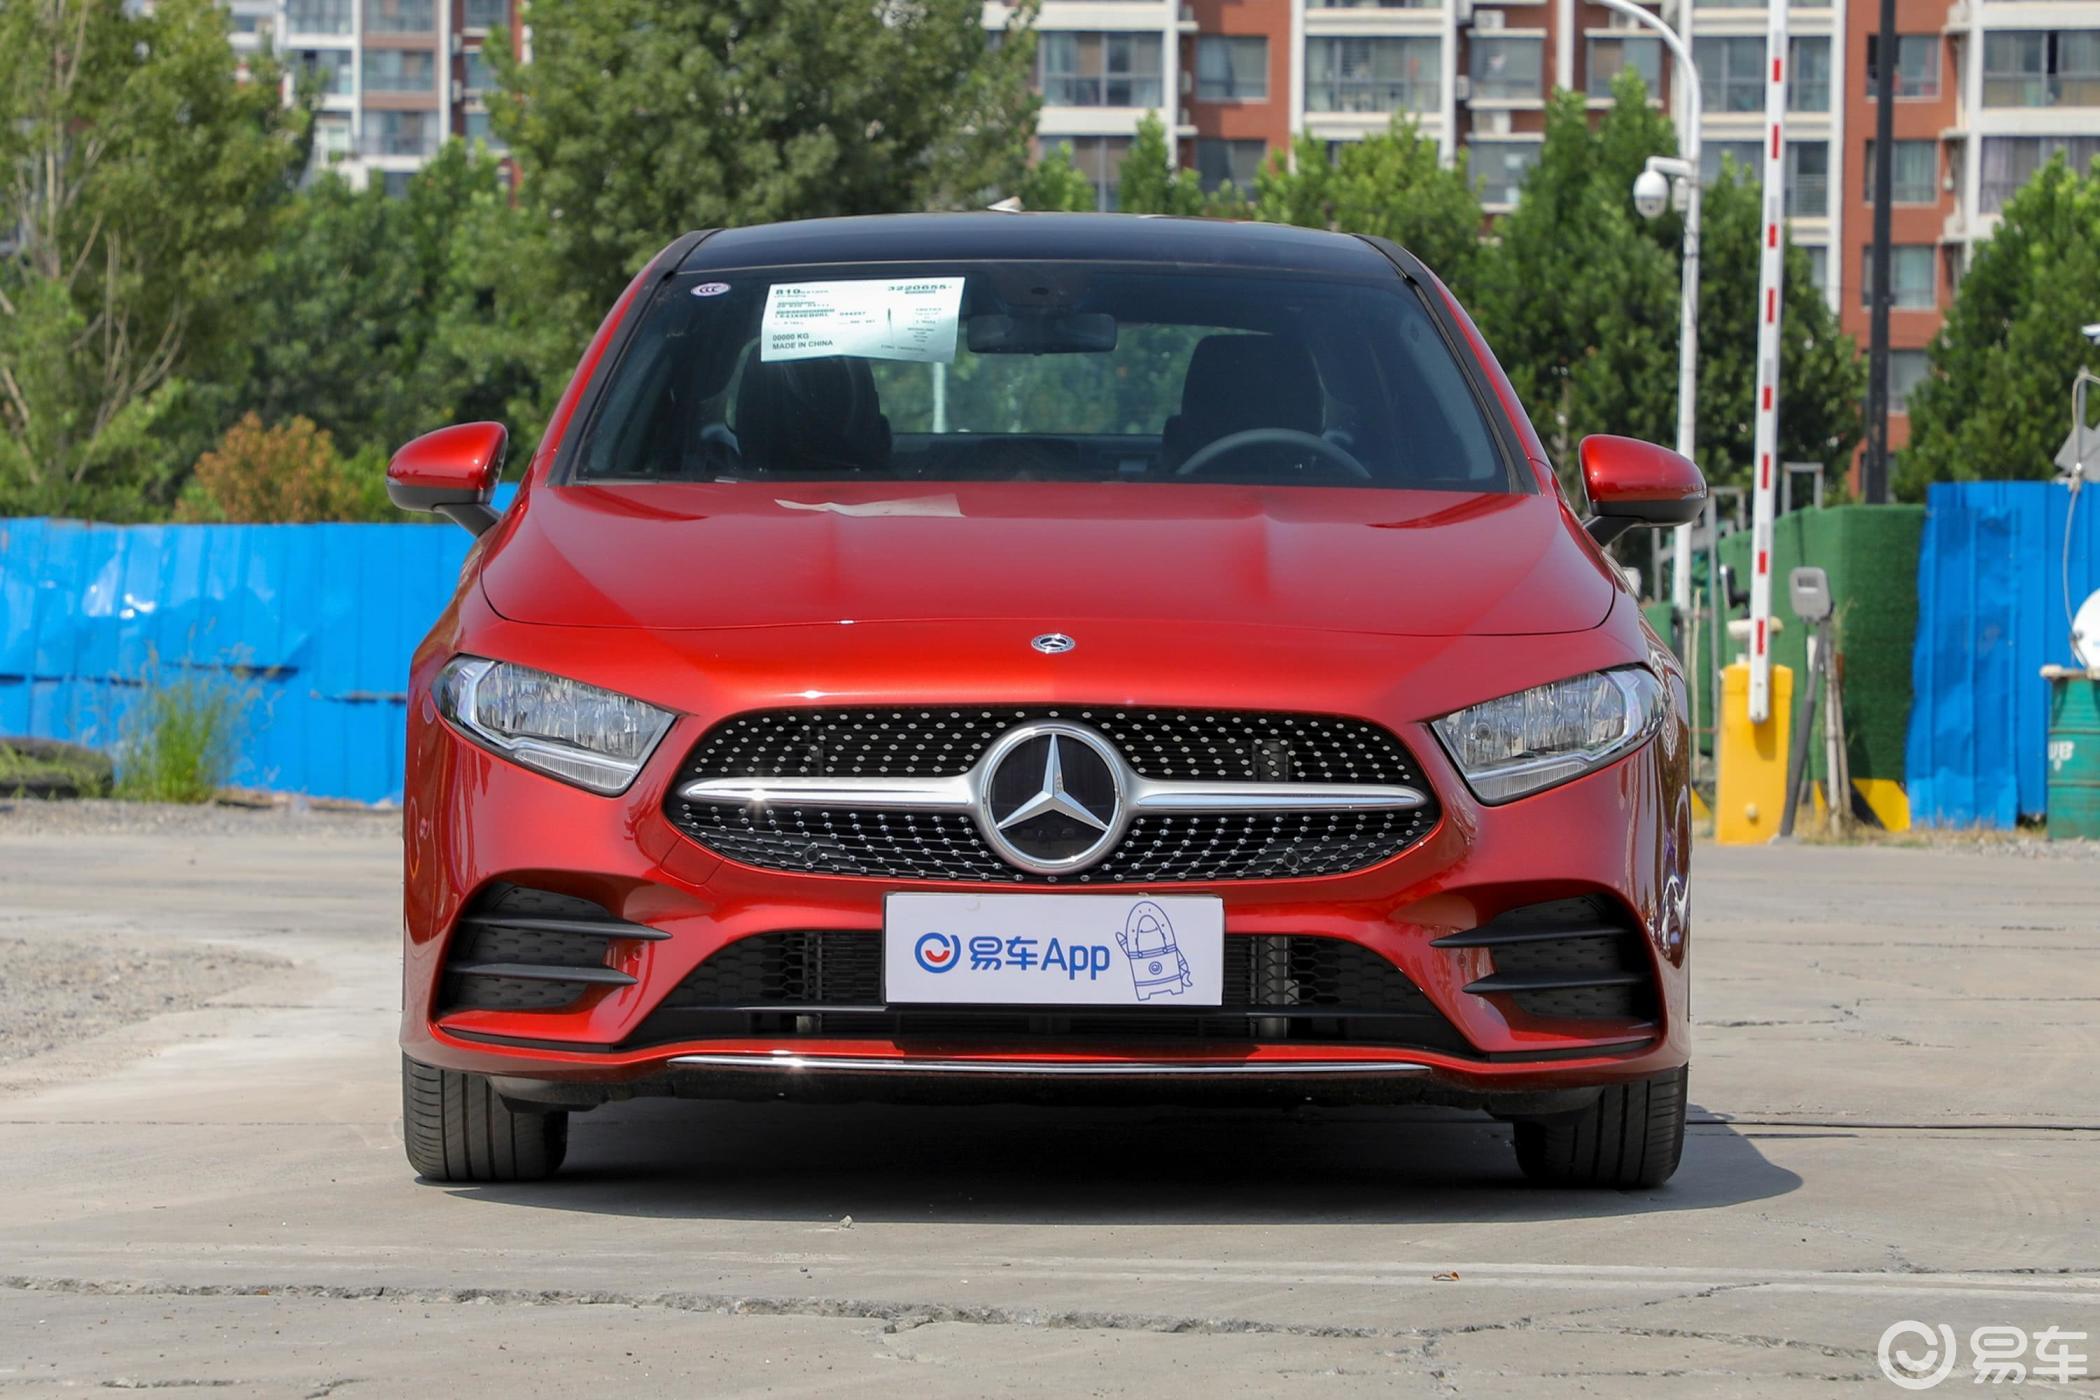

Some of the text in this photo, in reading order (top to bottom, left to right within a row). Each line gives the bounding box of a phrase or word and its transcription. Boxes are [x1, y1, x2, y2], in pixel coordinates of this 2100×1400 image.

[797, 332, 810, 340] KG
[772, 341, 797, 350] MADE
[808, 339, 834, 348] CHINA
[968, 935, 1111, 980] 易车App
